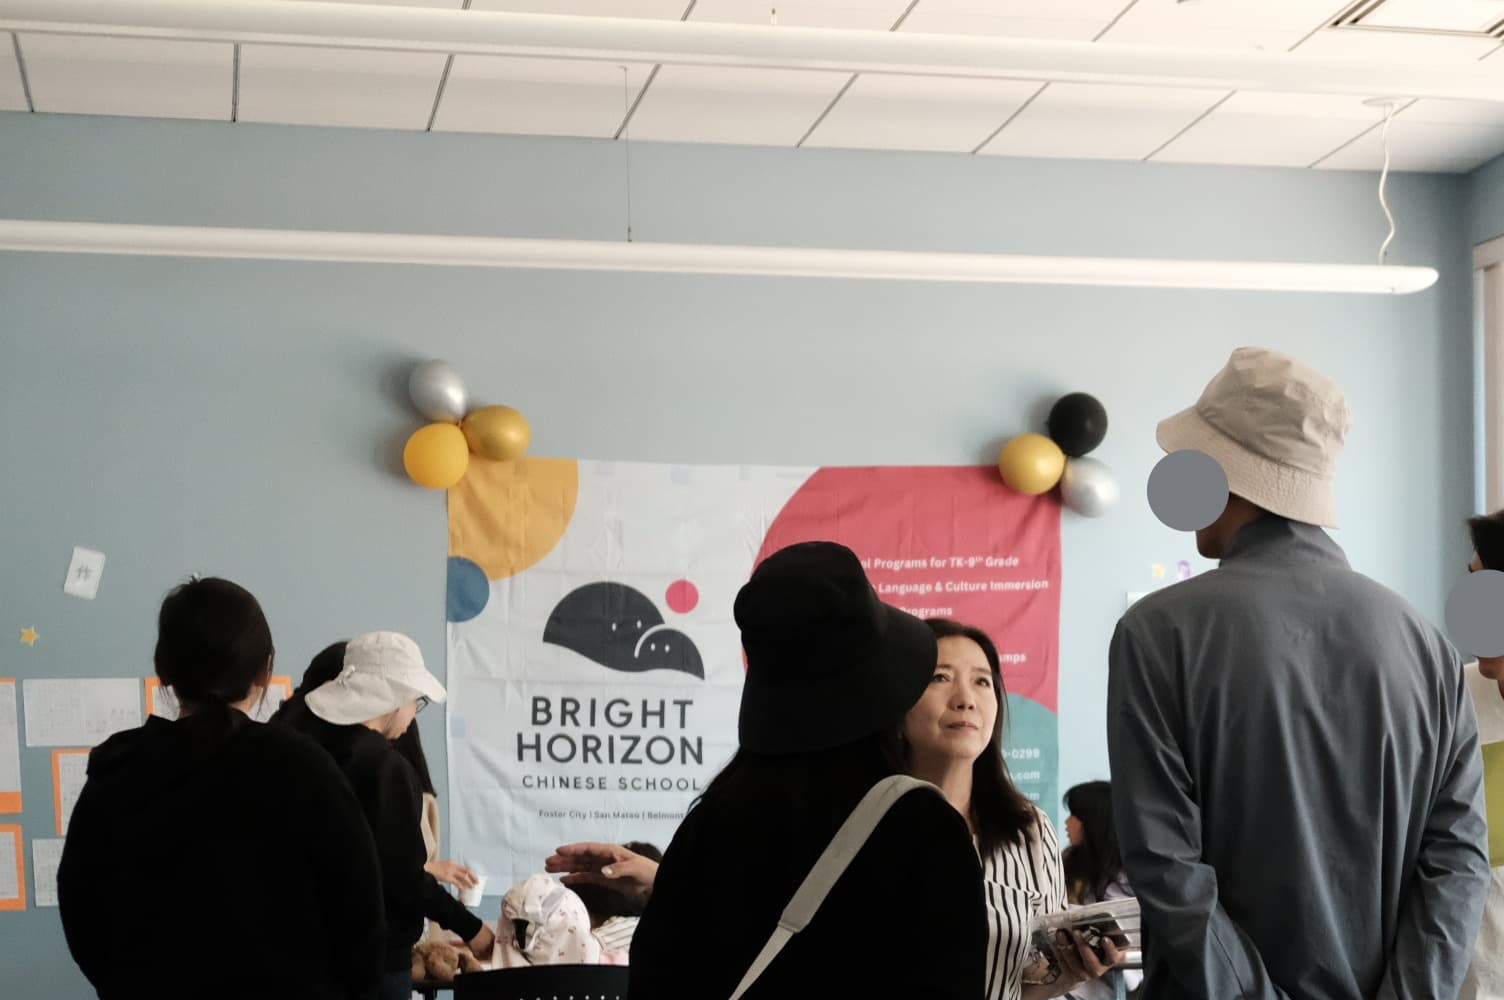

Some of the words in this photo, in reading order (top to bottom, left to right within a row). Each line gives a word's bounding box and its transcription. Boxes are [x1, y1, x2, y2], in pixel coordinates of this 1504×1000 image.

[874, 558, 927, 571] Programs
[930, 557, 946, 568] for
[985, 556, 1018, 567] Grade
[878, 583, 932, 595] Language
[934, 582, 942, 592] &
[945, 581, 988, 592] Culture
[990, 579, 1049, 590] Immersion
[531, 696, 693, 728] BRIGHT
[516, 732, 703, 765] HORIZON
[522, 775, 607, 790] CHINESE
[618, 777, 701, 791] SCHOOL
[569, 809, 586, 820] City
